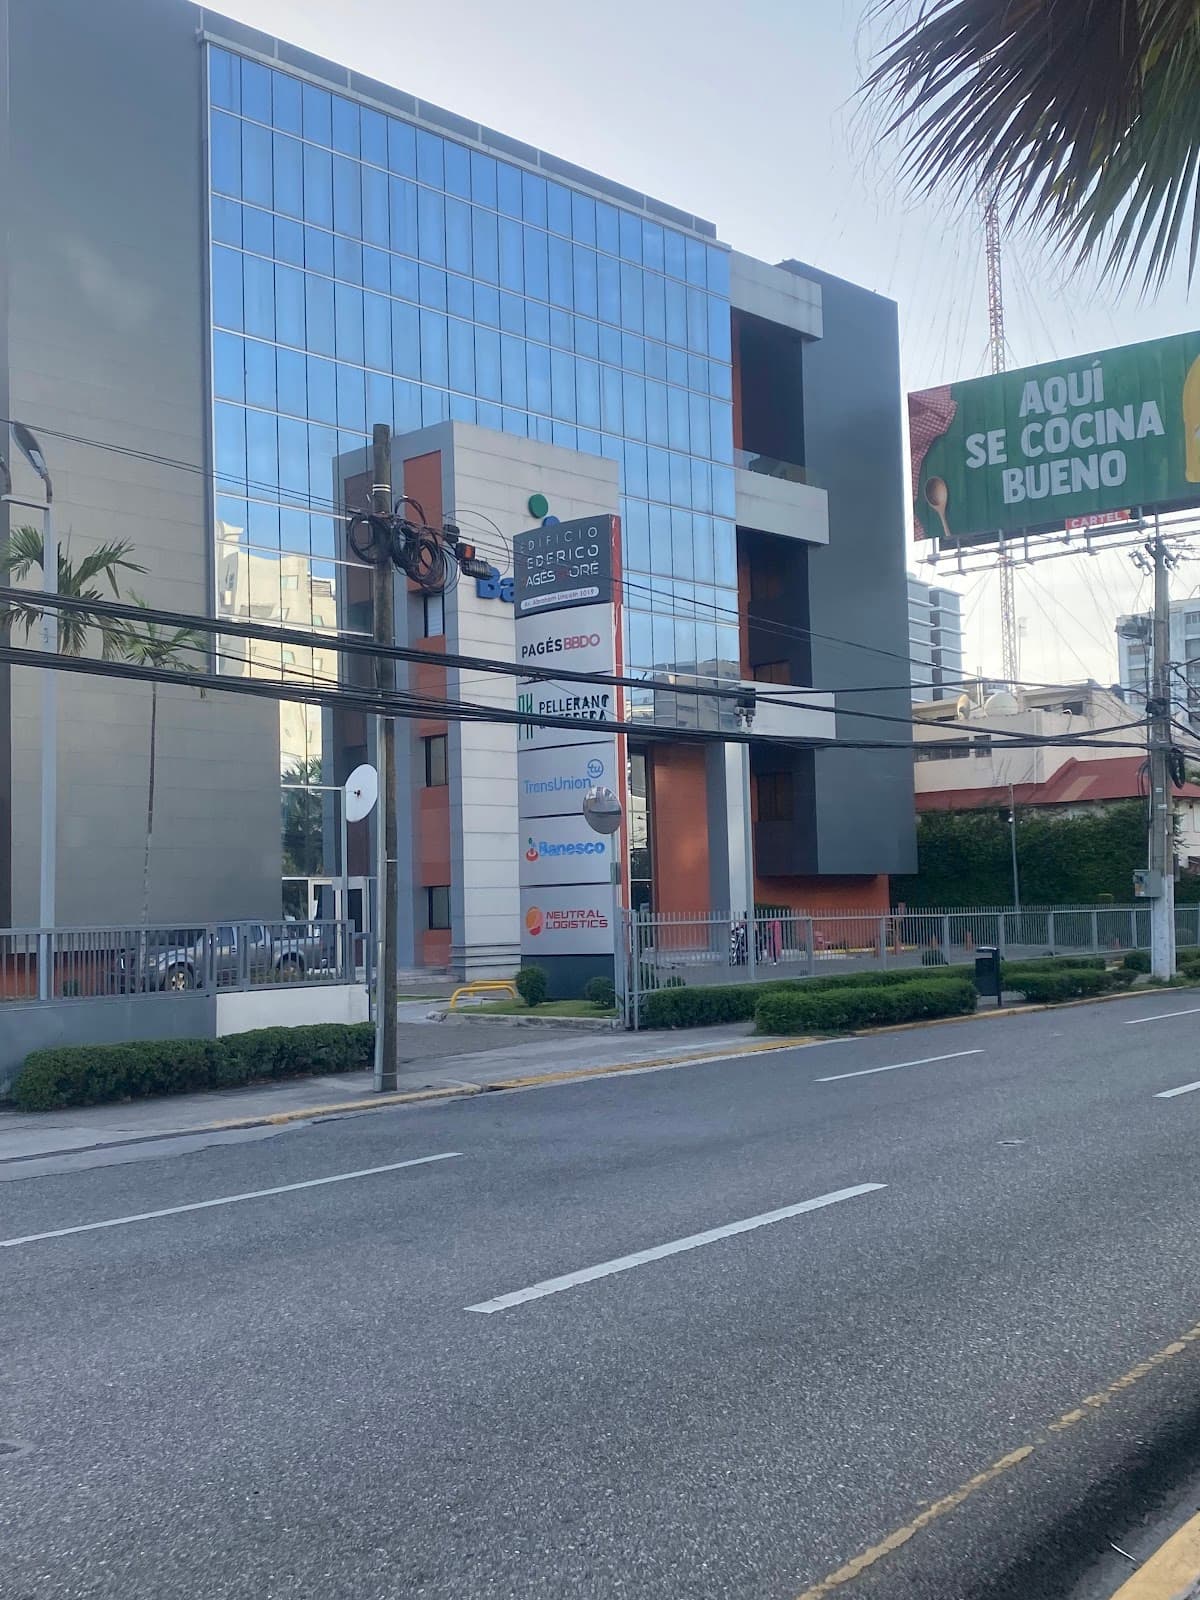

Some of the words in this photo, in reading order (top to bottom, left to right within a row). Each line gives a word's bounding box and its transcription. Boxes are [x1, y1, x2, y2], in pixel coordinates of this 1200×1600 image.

[1019, 360, 1104, 418] AQUÍ
[965, 428, 1008, 469] SE
[1020, 400, 1166, 458] COCINA
[1002, 449, 1127, 504] BUENO
[1071, 511, 1122, 528] CARTEL
[525, 544, 599, 570] EDERICO
[524, 776, 591, 794] TransUnion
[539, 841, 605, 856] Banesco
[546, 909, 604, 919] NEUTRAL
[545, 919, 608, 929] LOGISTICS
